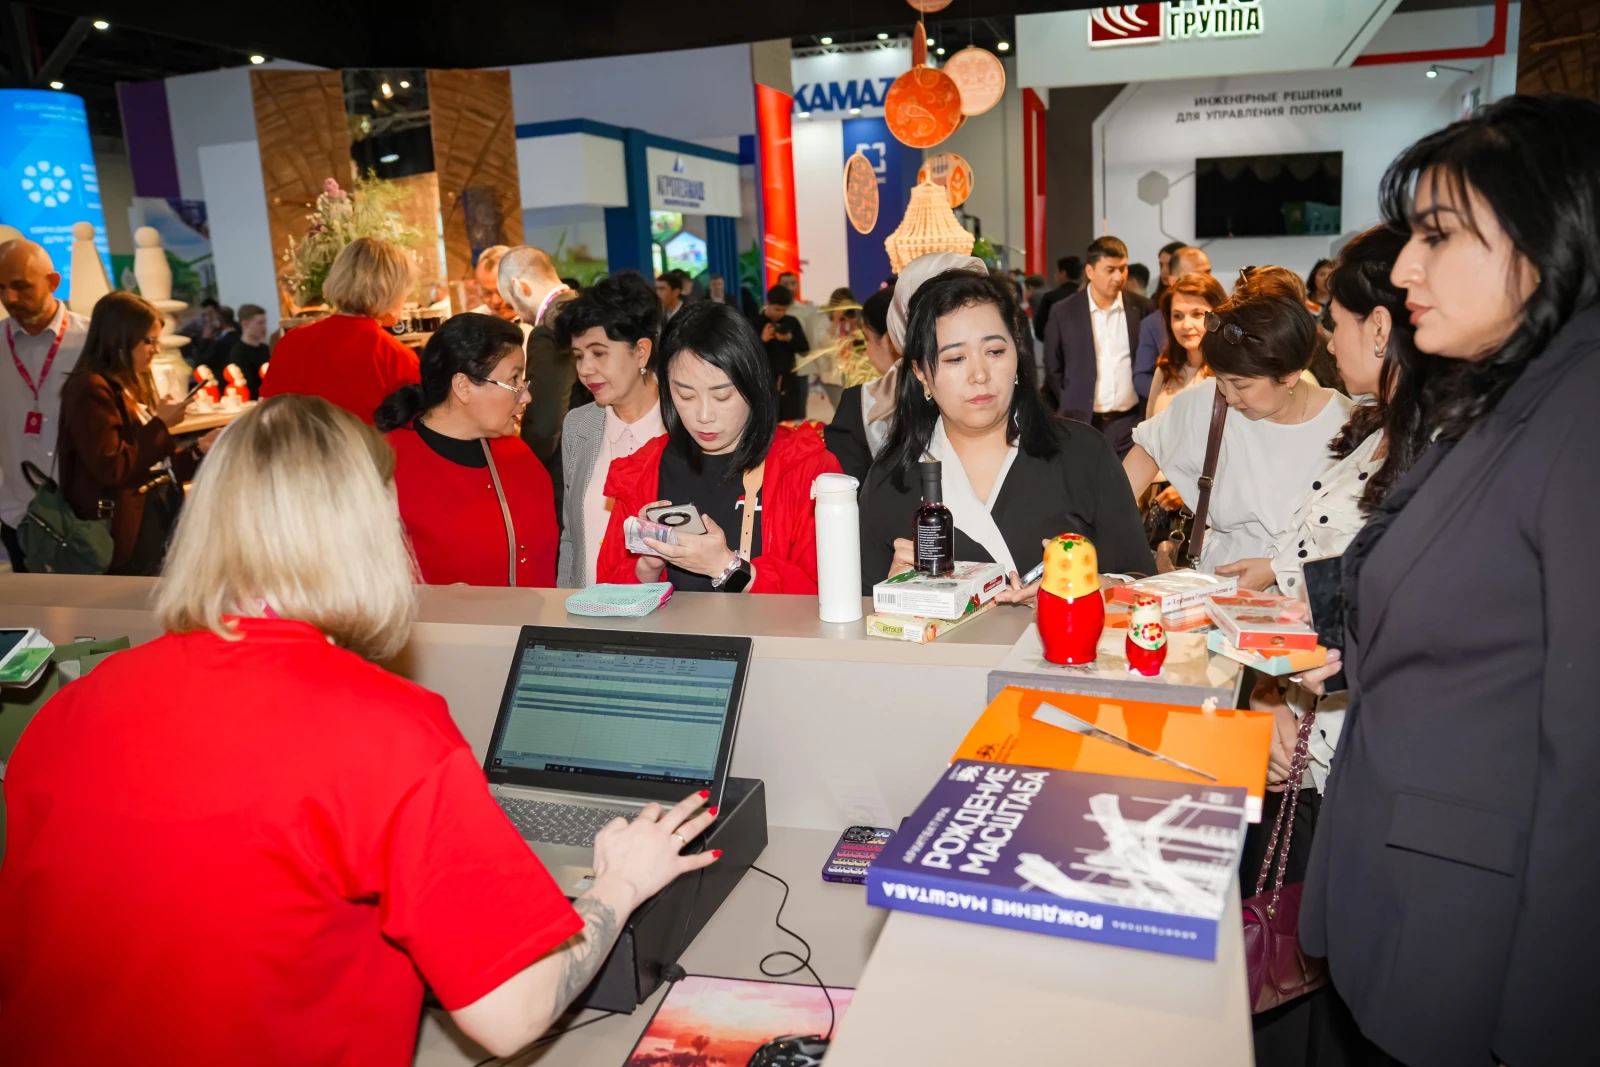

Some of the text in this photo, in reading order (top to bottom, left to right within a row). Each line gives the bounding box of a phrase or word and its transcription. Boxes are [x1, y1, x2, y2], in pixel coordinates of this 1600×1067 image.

[1170, 7, 1260, 36] ГРУППА
[1175, 102, 1362, 123] ДЛЯ УПРАВЛЕНИЯ ПОТОКАМИ
[1194, 87, 1343, 107] ИНЖЕНЕРНЫЕ РЕШЕНИЯ
[920, 766, 1017, 870] РОЖДЕНИЕ
[958, 771, 1050, 876] МАСШТАБА
[881, 880, 989, 913] МАСШТАБА
[991, 898, 1104, 931] РОЖДЕНИЕ
